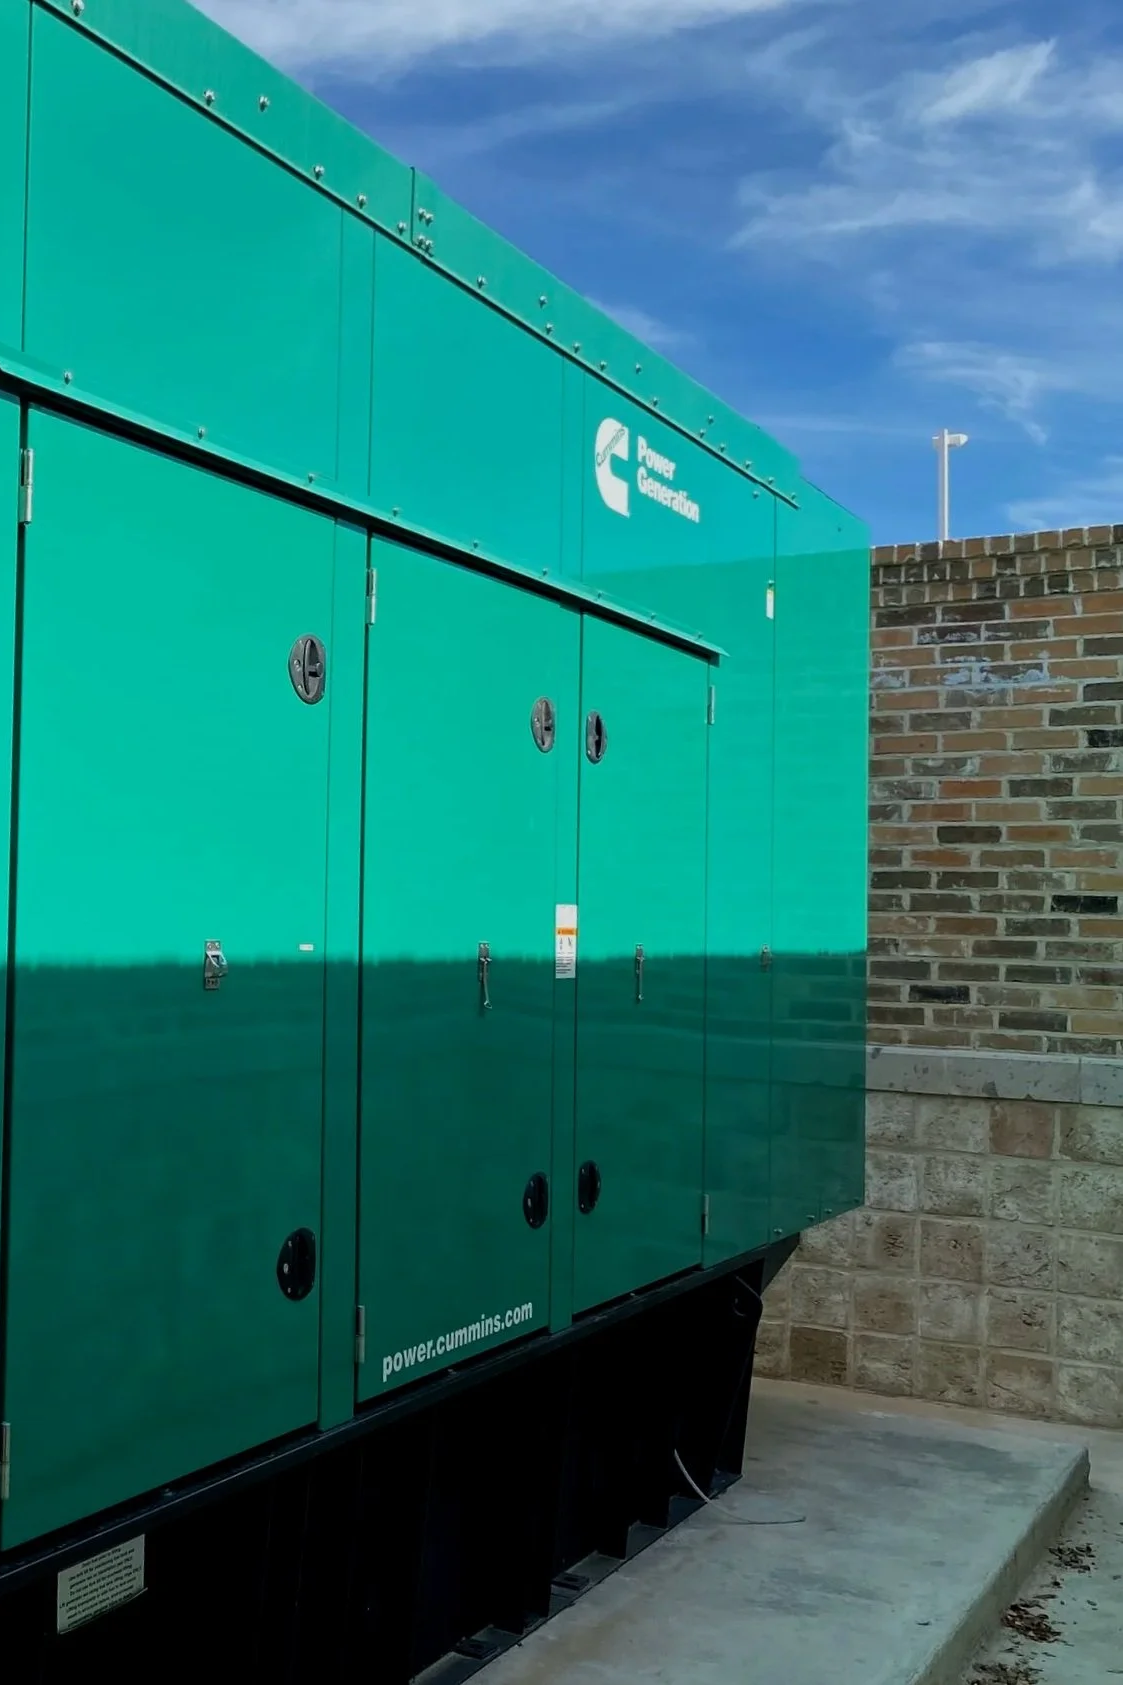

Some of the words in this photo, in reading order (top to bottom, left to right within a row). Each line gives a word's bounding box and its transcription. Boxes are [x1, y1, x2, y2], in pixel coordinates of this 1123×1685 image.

[637, 435, 676, 481] Power
[637, 466, 700, 524] Generation
[382, 1302, 533, 1383] power.cummins.com
